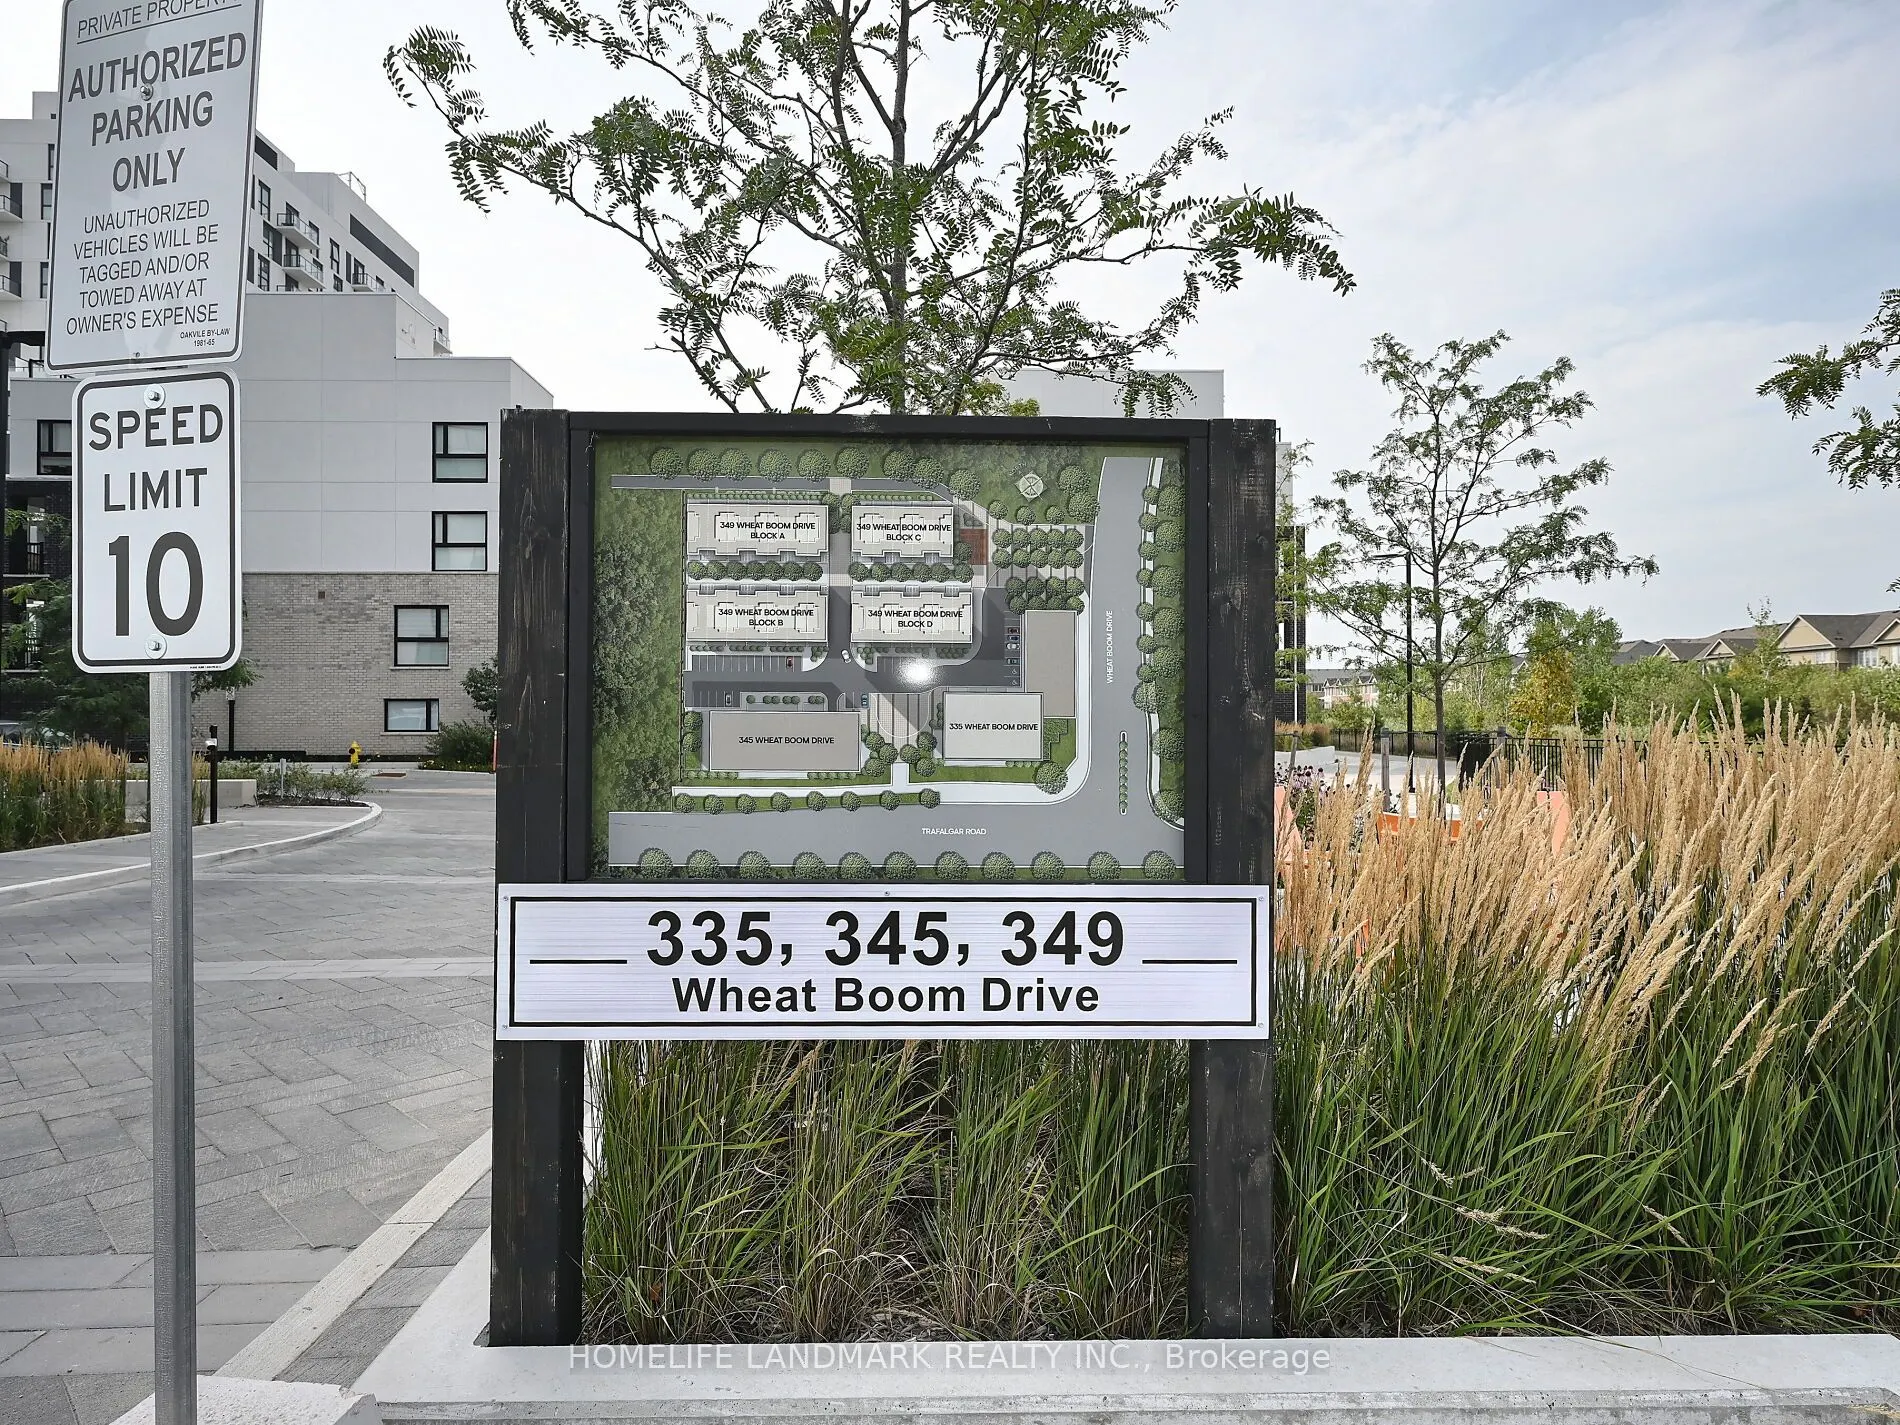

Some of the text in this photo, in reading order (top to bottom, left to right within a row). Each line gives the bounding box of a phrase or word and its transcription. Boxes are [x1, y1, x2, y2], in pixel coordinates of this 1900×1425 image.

[78, 6, 142, 38] PRIVATE
[68, 32, 247, 102] AUTHORIZED
[92, 91, 213, 147] PARKING
[113, 148, 186, 192] ONLY
[84, 199, 210, 233] UNAUTHORIZED
[74, 224, 219, 260] VEHICLES WILL BE
[80, 252, 209, 284] TAGGED AND/OR
[80, 278, 207, 309] TOWED AWAY AT
[66, 303, 219, 335] OWNER'S EXPENSE
[206, 327, 231, 337] BY-LAW
[89, 403, 223, 451] SPEED
[104, 468, 208, 512] LIMIT
[108, 531, 204, 637] 10
[646, 910, 1124, 967] 335, 345, 349
[671, 978, 1100, 1013] Wheat Boom Drive
